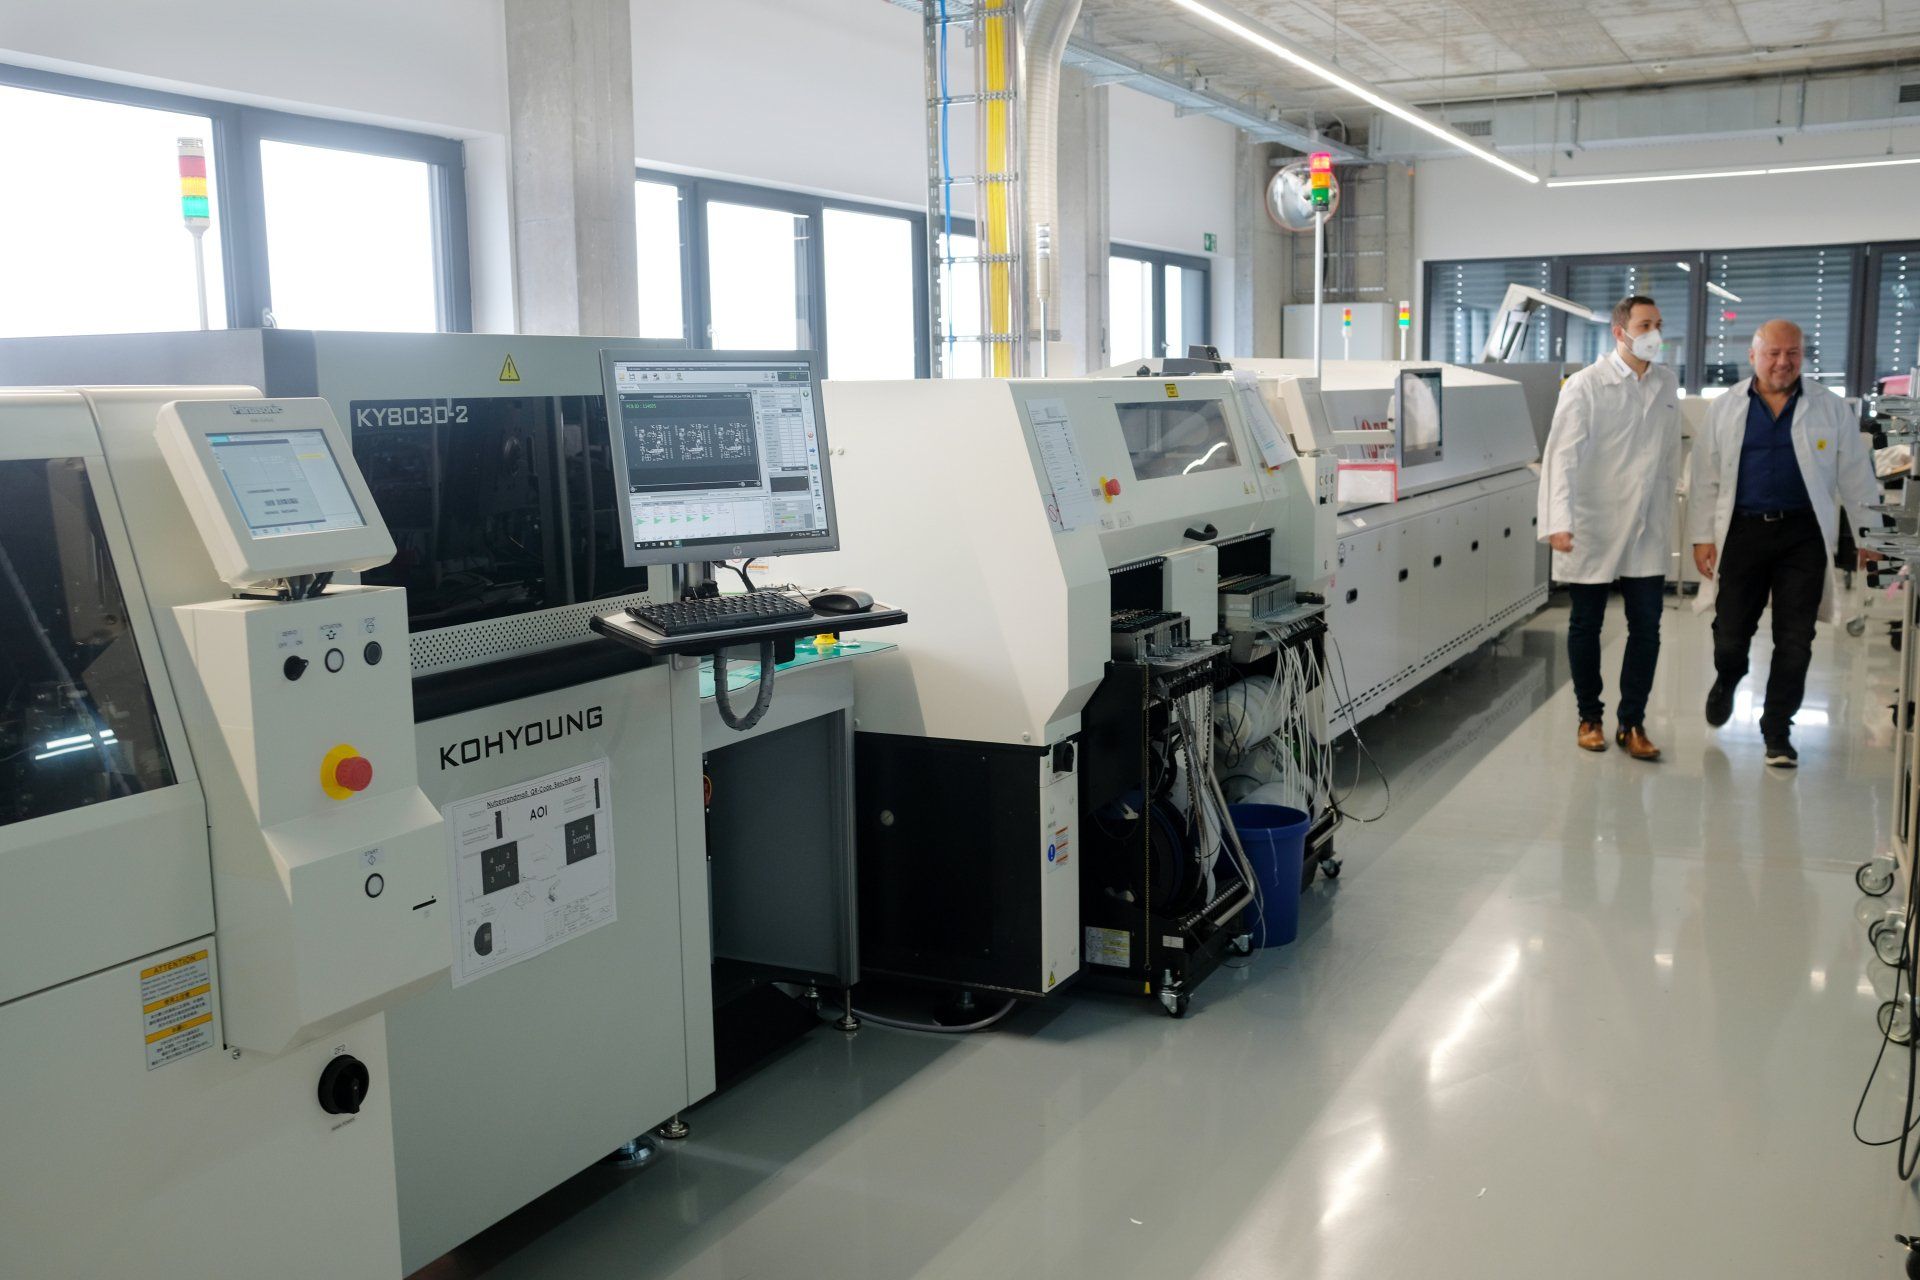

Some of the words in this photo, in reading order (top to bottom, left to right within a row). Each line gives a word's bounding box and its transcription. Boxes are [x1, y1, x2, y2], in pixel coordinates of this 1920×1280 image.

[357, 405, 468, 427] KY8030-2
[440, 706, 603, 770] KOHYOUNG
[529, 804, 548, 821] AOI
